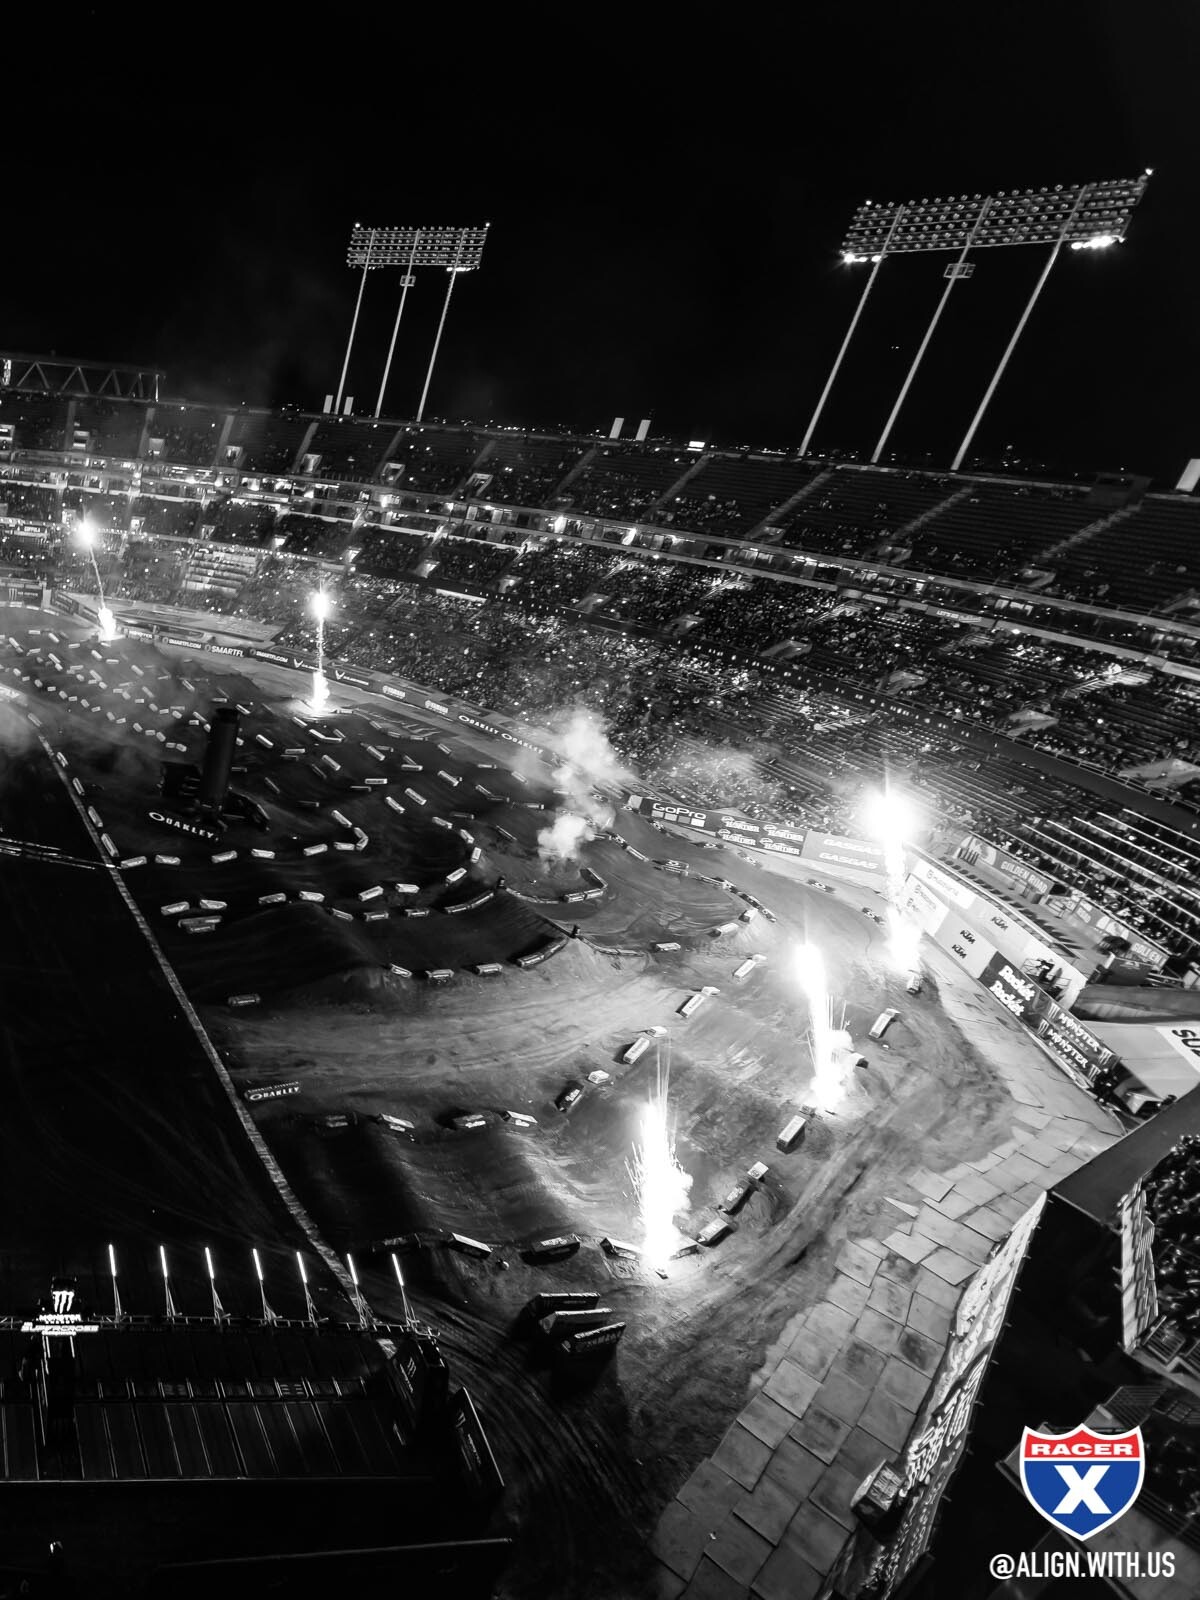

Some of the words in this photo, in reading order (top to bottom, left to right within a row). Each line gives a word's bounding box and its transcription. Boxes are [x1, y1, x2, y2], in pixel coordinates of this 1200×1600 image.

[652, 802, 707, 820] GoPro
[166, 817, 214, 838] OAKLEY
[818, 852, 879, 870] GASGAS
[1000, 860, 1030, 881] GOLDEN
[991, 916, 1009, 931] KTM
[960, 930, 976, 944] KTM
[951, 944, 967, 959] KTM
[1047, 1029, 1089, 1069] MONSTER
